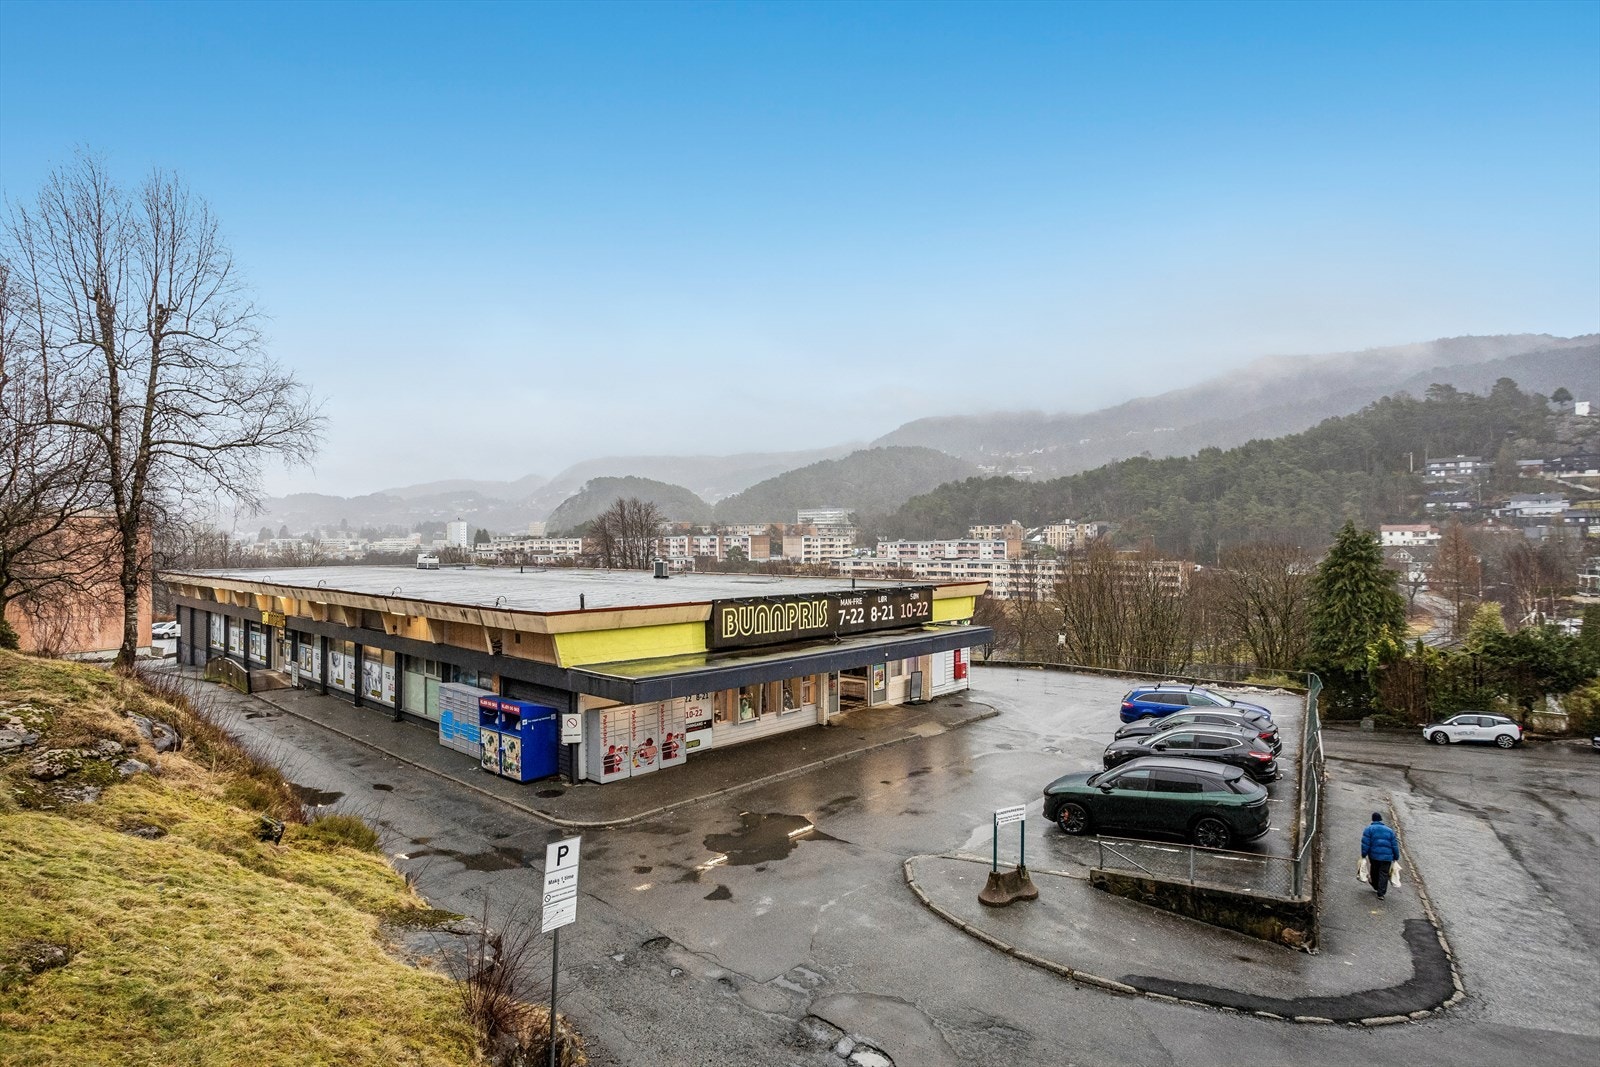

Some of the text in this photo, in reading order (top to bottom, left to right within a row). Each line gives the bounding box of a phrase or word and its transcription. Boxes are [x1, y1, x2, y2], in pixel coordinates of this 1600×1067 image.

[840, 592, 920, 606] MAN-FRE LØR SØN
[722, 600, 828, 638] BUNNPRIS
[838, 601, 929, 626] 7-22 8-21 10-22
[686, 709, 703, 719] 10-22
[557, 845, 569, 866] P
